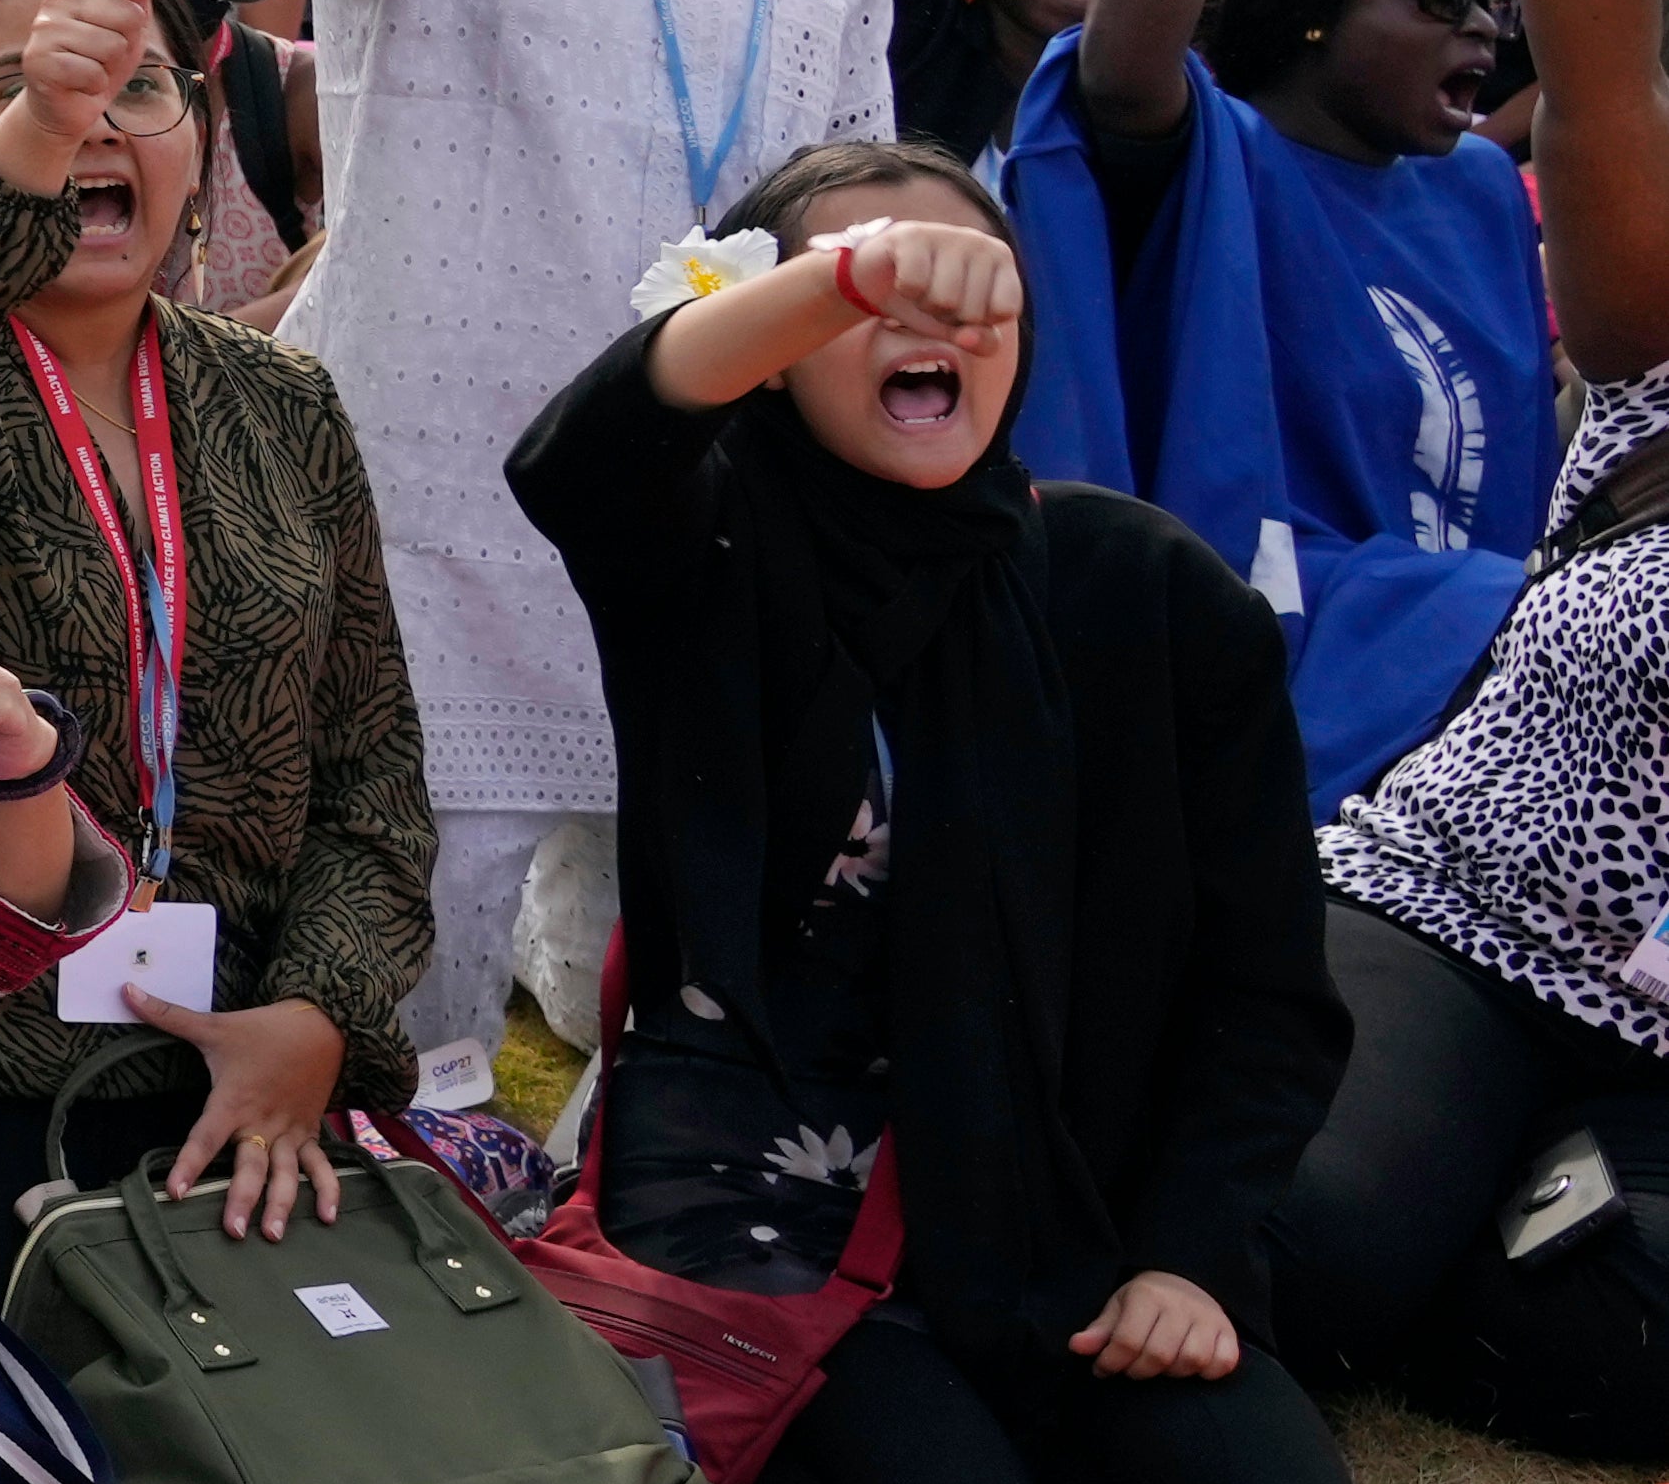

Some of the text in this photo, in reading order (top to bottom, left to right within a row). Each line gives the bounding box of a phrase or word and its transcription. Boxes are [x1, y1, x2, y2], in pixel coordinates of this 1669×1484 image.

[47, 374, 71, 415] ACTION
[139, 377, 156, 419] HUMAN
[76, 446, 100, 493] HUMAN
[149, 452, 176, 604] SPACE FOR CLIMATE ACTION
